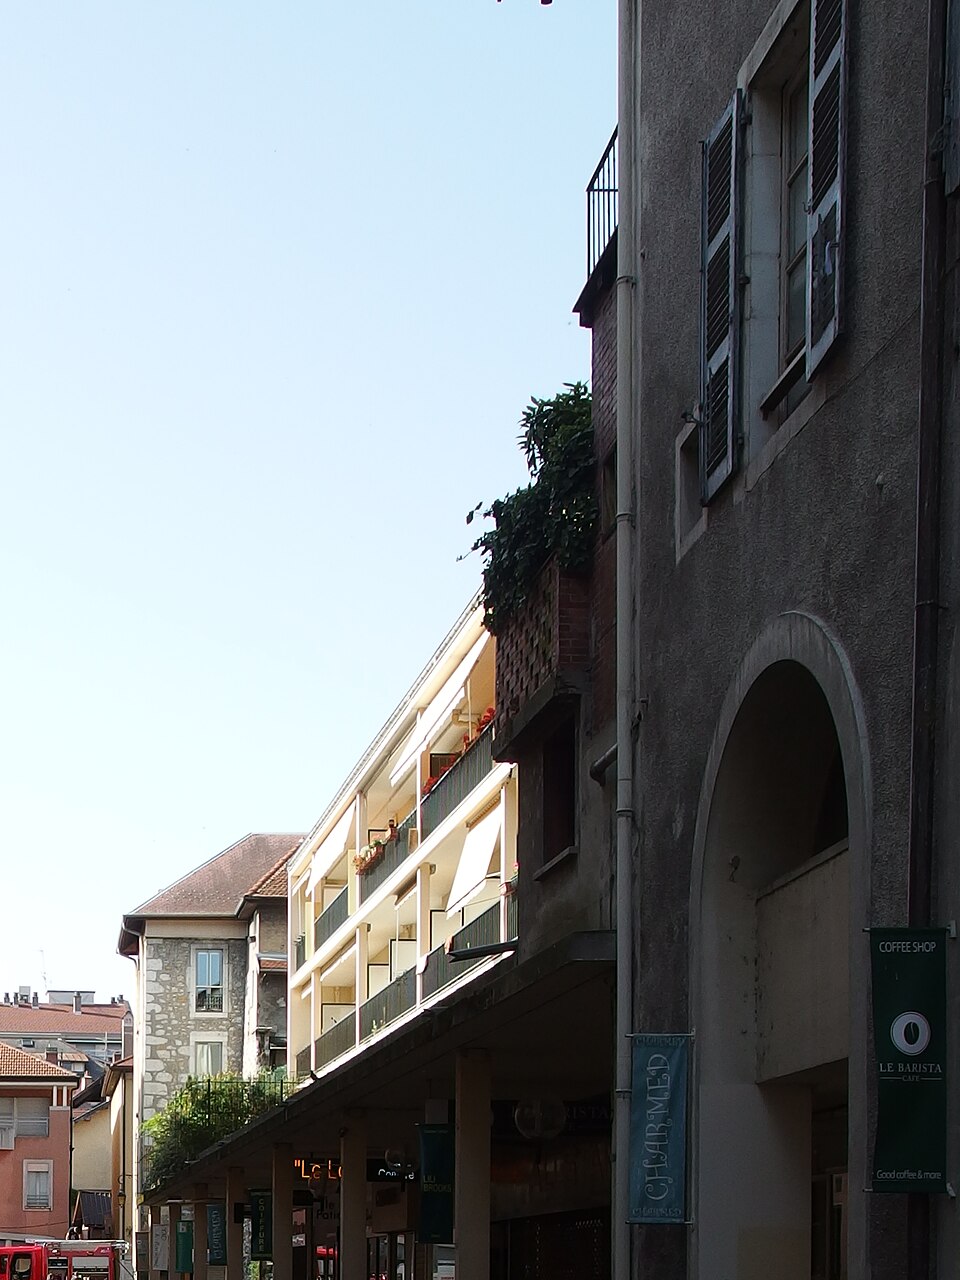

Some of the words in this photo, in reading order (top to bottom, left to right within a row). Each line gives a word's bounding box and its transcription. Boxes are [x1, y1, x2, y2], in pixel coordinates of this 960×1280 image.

[879, 942, 911, 952] COFFEE
[913, 942, 936, 952] SHOP
[880, 1063, 894, 1072] LE
[898, 1063, 942, 1073] BARISTA
[643, 1053, 673, 1200] CHARMED
[877, 1170, 895, 1179] Good
[896, 1170, 916, 1179] coffee
[918, 1170, 923, 1179] &
[924, 1171, 941, 1179] more
